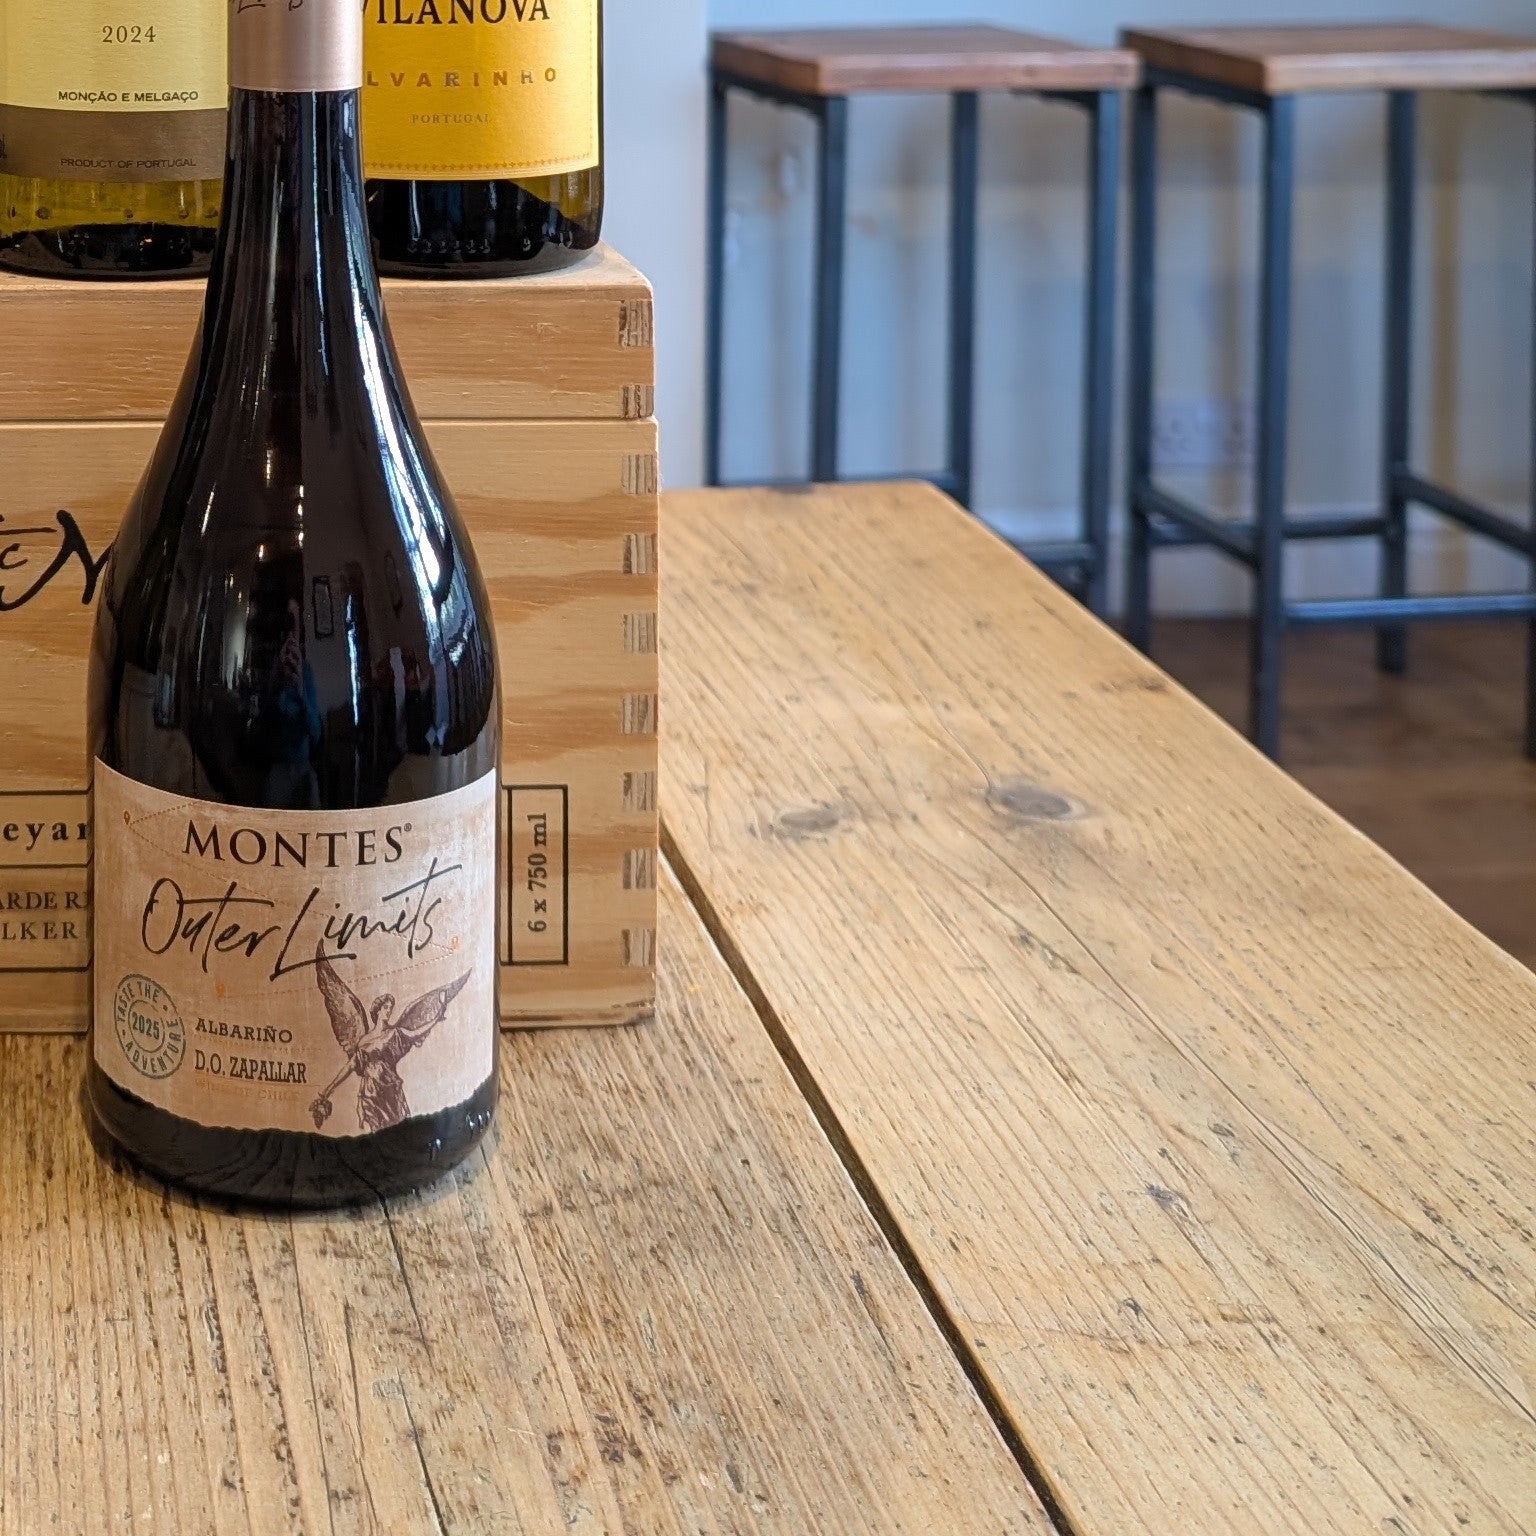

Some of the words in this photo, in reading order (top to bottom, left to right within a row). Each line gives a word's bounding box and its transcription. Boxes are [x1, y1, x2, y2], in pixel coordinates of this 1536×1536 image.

[102, 25, 157, 44] 2024
[366, 67, 557, 88] LVARINHO
[58, 91, 117, 104] MONÇÃO
[122, 92, 130, 101] E
[134, 91, 199, 103] MELGAÇO
[61, 158, 115, 168] PRODUCT
[118, 160, 132, 168] OF
[136, 158, 196, 168] PORTUGAL
[527, 813, 547, 847] ml
[527, 852, 547, 891] 750
[534, 899, 547, 913] x
[269, 857, 463, 982] Limits
[527, 920, 547, 933] 6
[116, 982, 136, 1022] TASTE
[137, 981, 161, 1003] THE
[131, 1012, 160, 1040] 2025
[195, 1017, 293, 1043] ALBARIÑO
[195, 1049, 225, 1076] D.O.
[230, 1056, 307, 1084] ZAPALLAR
